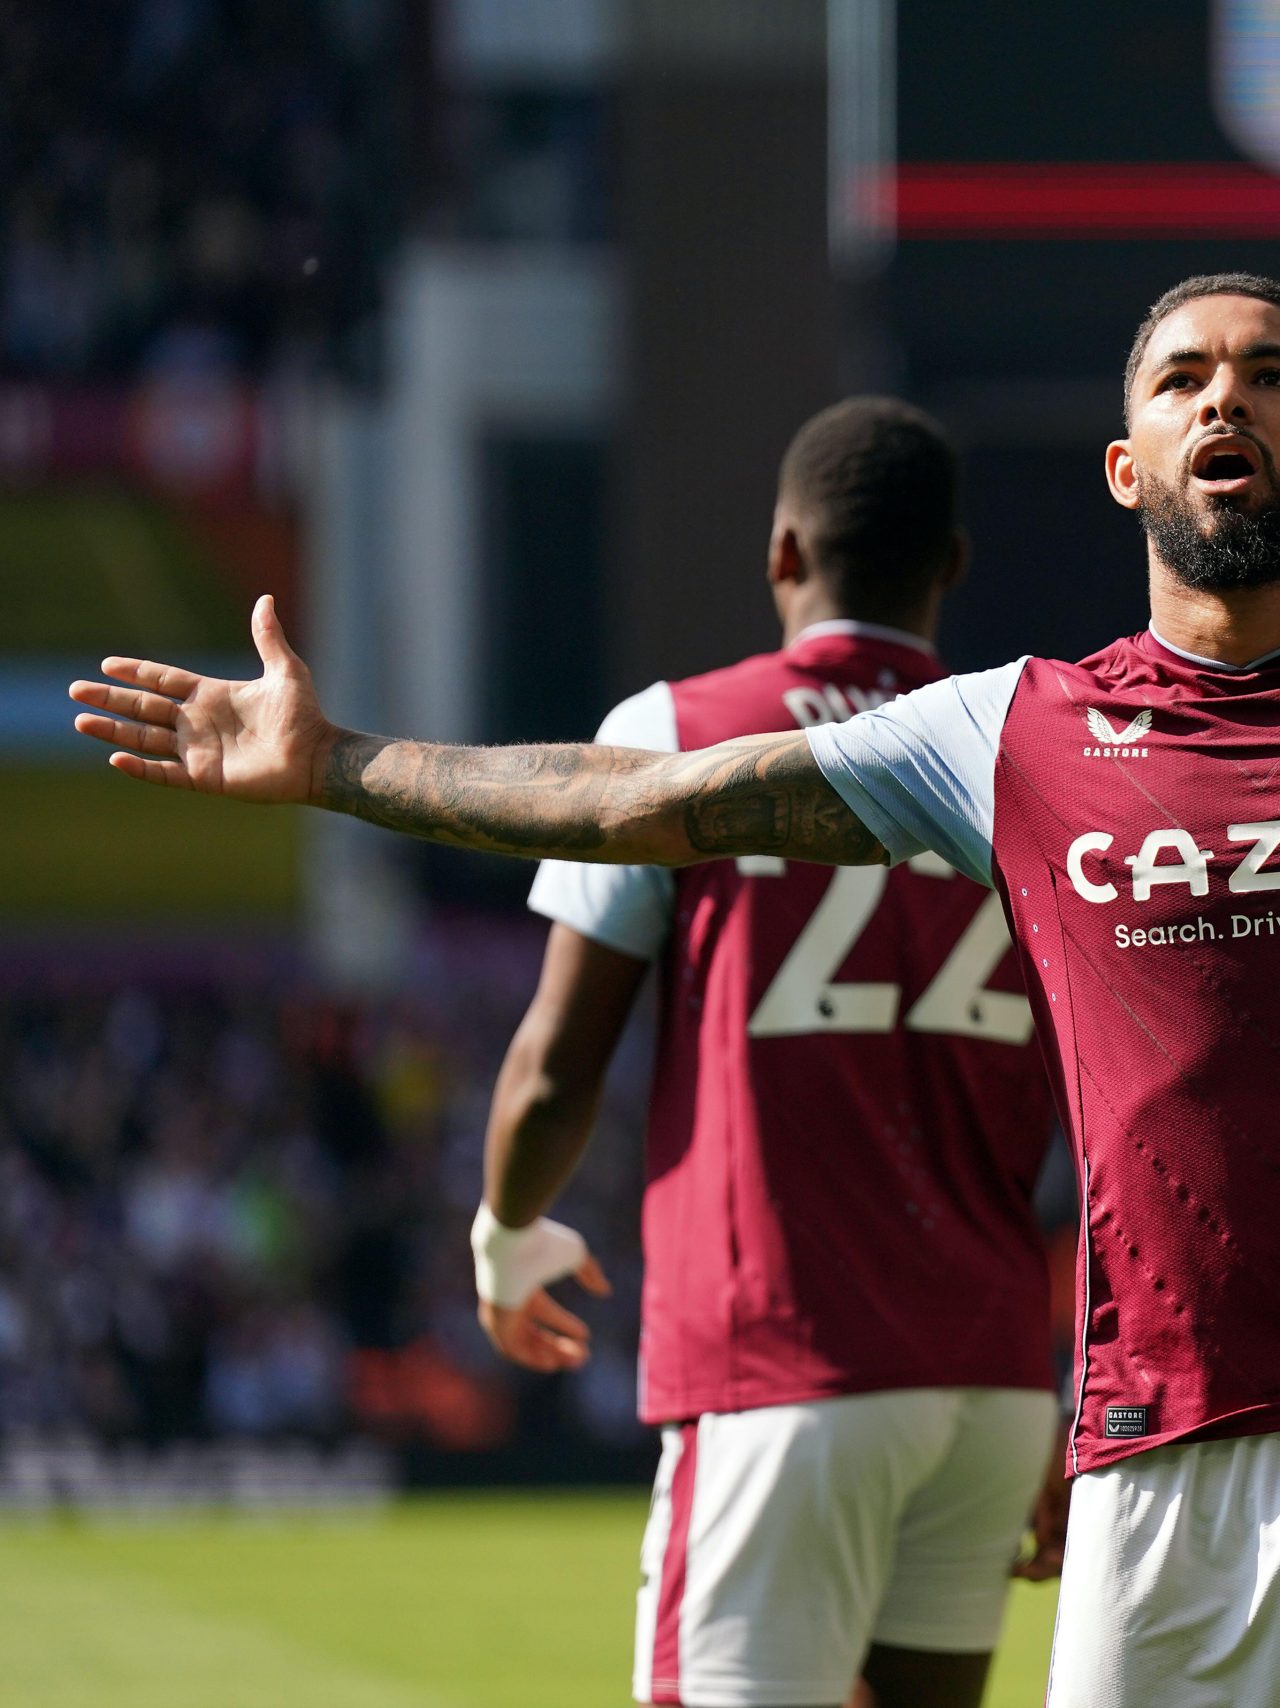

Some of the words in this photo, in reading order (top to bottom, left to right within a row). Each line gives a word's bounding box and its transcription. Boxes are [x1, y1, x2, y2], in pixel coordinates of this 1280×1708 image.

[1083, 747, 1149, 758] CASTORE
[1114, 917, 1224, 949] Search.
[1108, 1411, 1143, 1419] CASTORE
